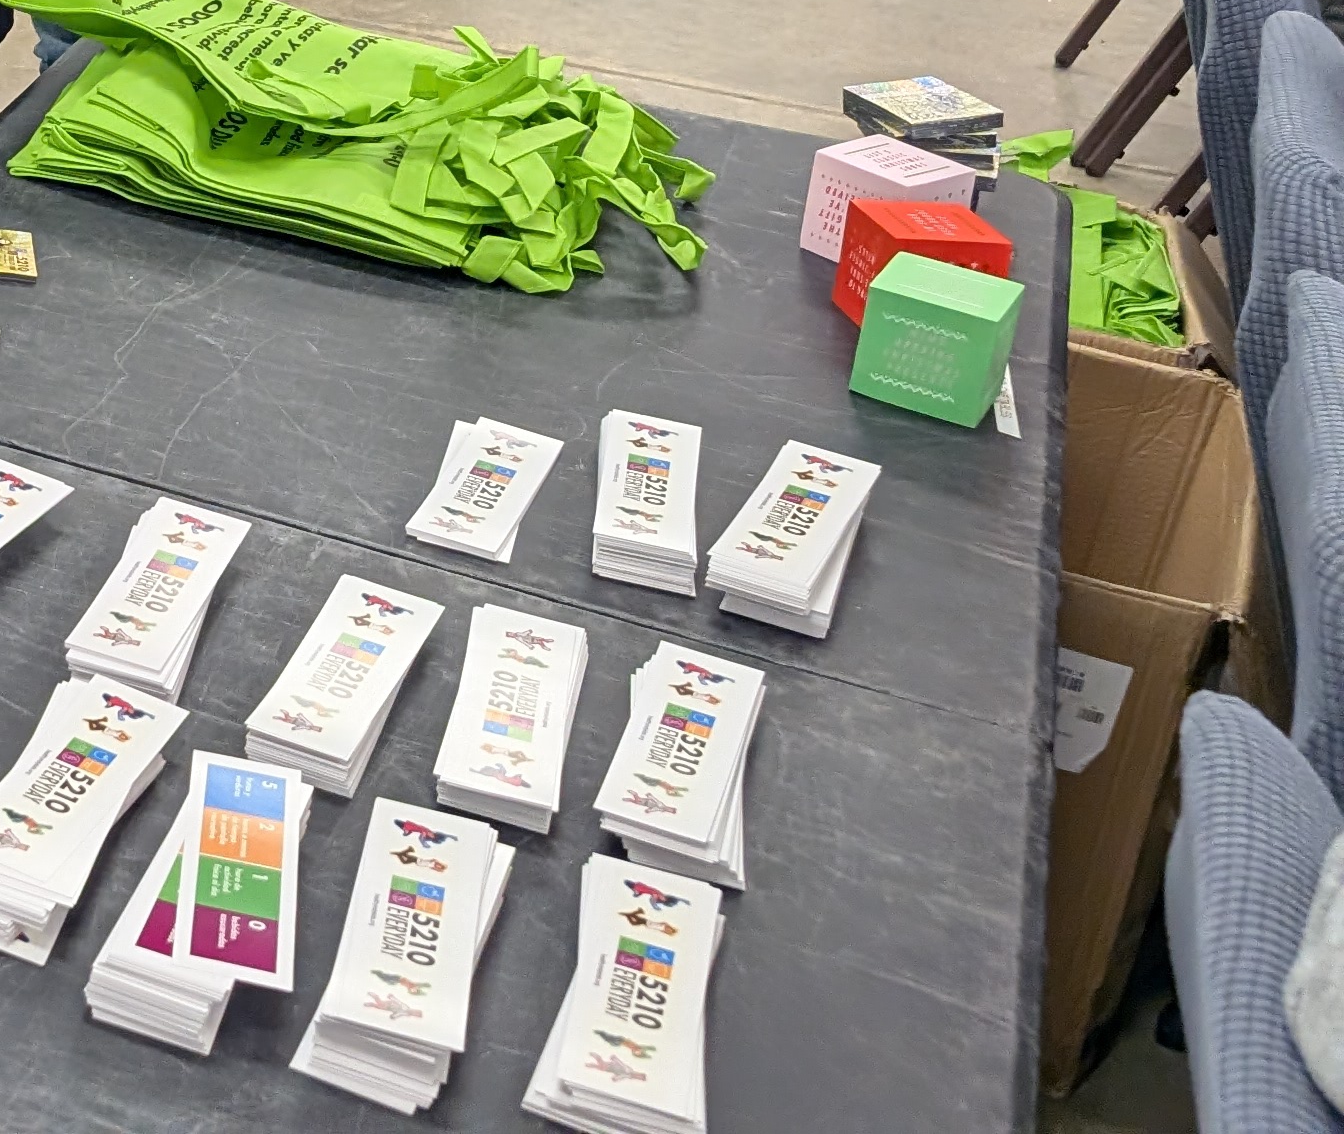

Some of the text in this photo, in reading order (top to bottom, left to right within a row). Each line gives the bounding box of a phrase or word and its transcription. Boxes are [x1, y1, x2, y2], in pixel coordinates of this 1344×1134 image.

[288, 38, 301, 52] y
[872, 152, 908, 164] CLASSIC
[879, 155, 925, 169] CHRISTMAS
[900, 162, 927, 171] SONGS
[818, 208, 842, 223] GIFT
[822, 224, 840, 236] THE
[453, 475, 484, 504] EVERYDAY
[472, 481, 506, 509] 5210
[623, 471, 644, 501] EVERYDAY
[643, 475, 668, 506] 5210
[762, 500, 795, 530] EVERYDAY
[783, 506, 819, 536] 5210
[124, 570, 161, 606] EVERYDAY
[145, 576, 185, 612] 5210
[306, 654, 346, 692] EVERYDAY
[328, 661, 370, 699] 5210
[488, 670, 518, 712] 5210
[515, 674, 541, 717] EVERYDAY
[646, 726, 679, 768] EVERYDAY
[670, 733, 706, 775] 5210
[23, 761, 71, 805] EVERYDAY
[45, 769, 95, 813] 5210
[261, 780, 278, 790] 5
[259, 823, 275, 831] 2
[248, 920, 267, 932] 0
[381, 906, 410, 960] EVERYDAY
[406, 912, 440, 966] 5210
[605, 967, 637, 1021] EVERYDAY
[632, 975, 668, 1030] 5210
